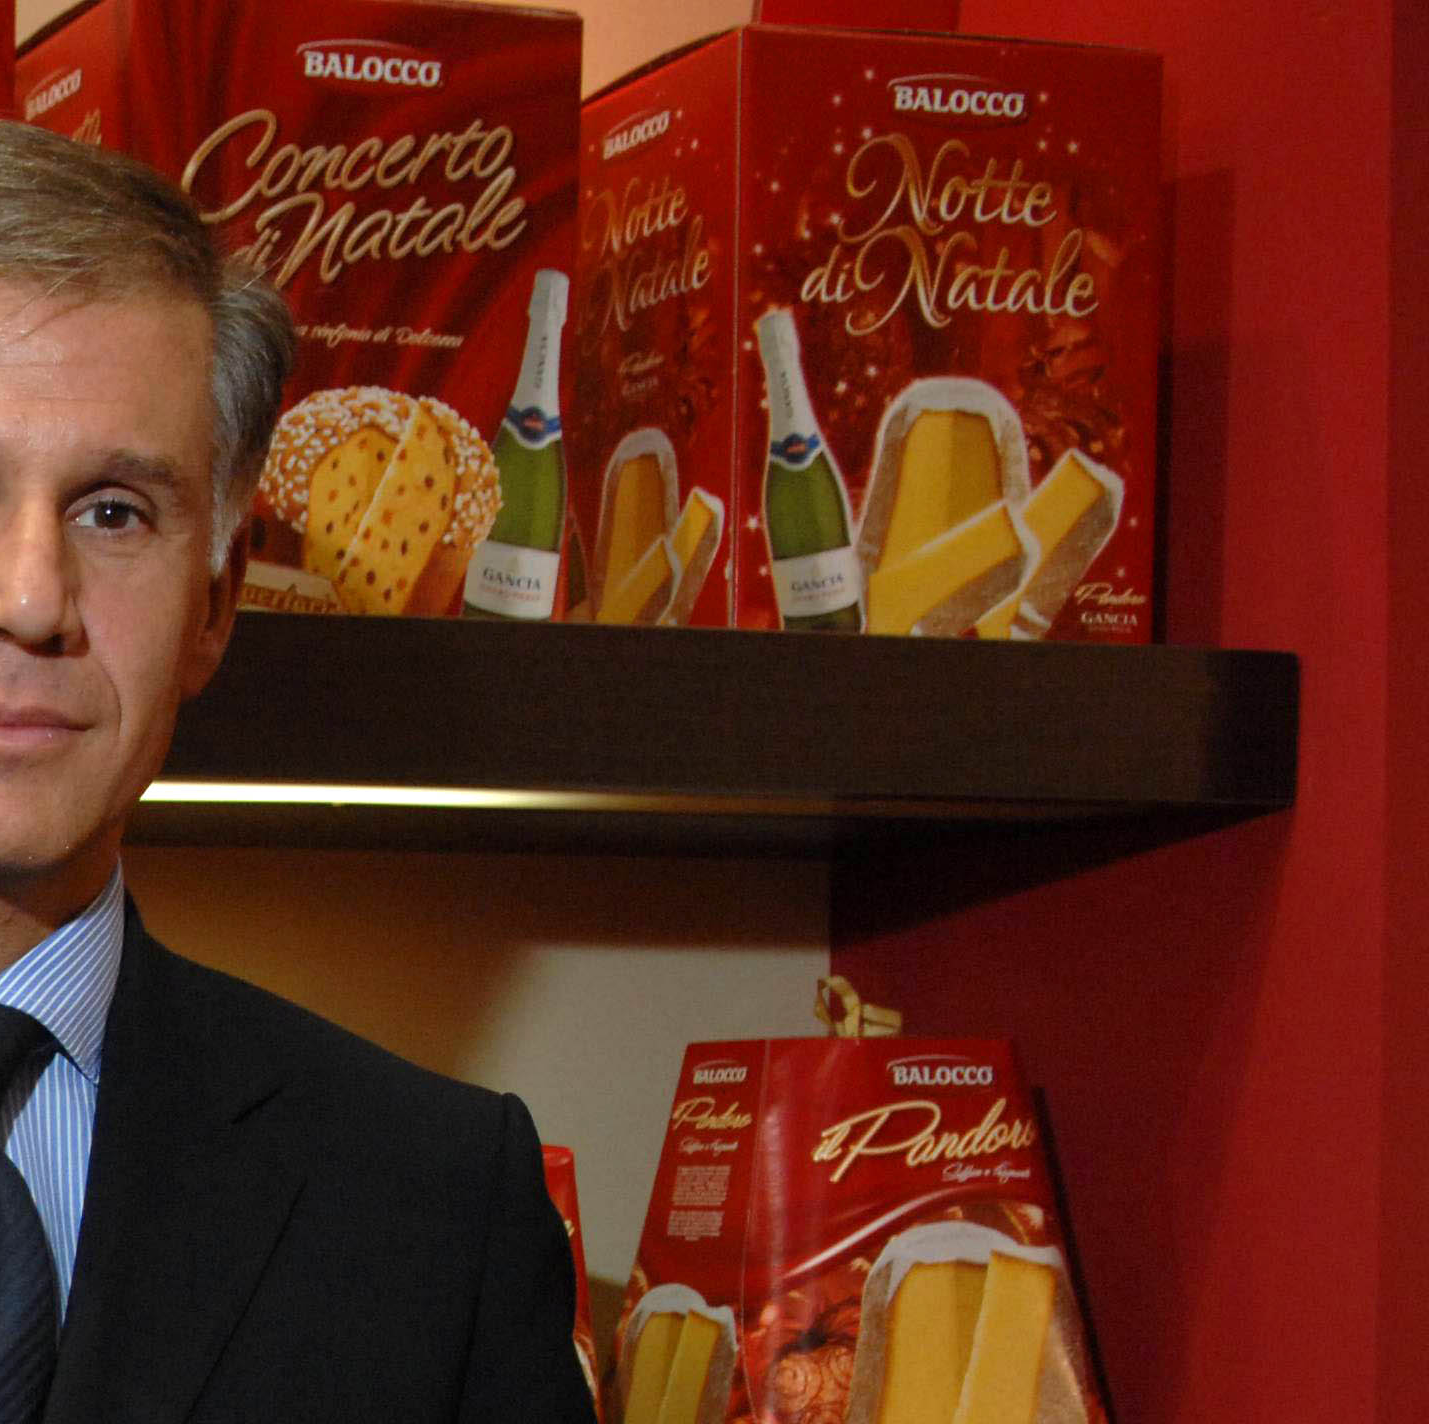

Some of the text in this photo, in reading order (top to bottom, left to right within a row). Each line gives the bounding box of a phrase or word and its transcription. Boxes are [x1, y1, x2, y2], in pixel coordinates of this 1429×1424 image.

[304, 49, 442, 87] BALOCCO
[894, 85, 1026, 118] BALOCCO
[181, 108, 514, 225] Concerto
[841, 134, 1059, 243] Notte
[255, 167, 527, 290] Natale
[801, 224, 1098, 336] di Natale
[482, 566, 541, 591] GANCIA
[790, 573, 845, 593] GANCIA
[1080, 611, 1139, 626] GANCIA
[693, 1066, 748, 1085] BALOCCO
[893, 1065, 993, 1086] BALOCCO
[811, 1124, 852, 1162] il
